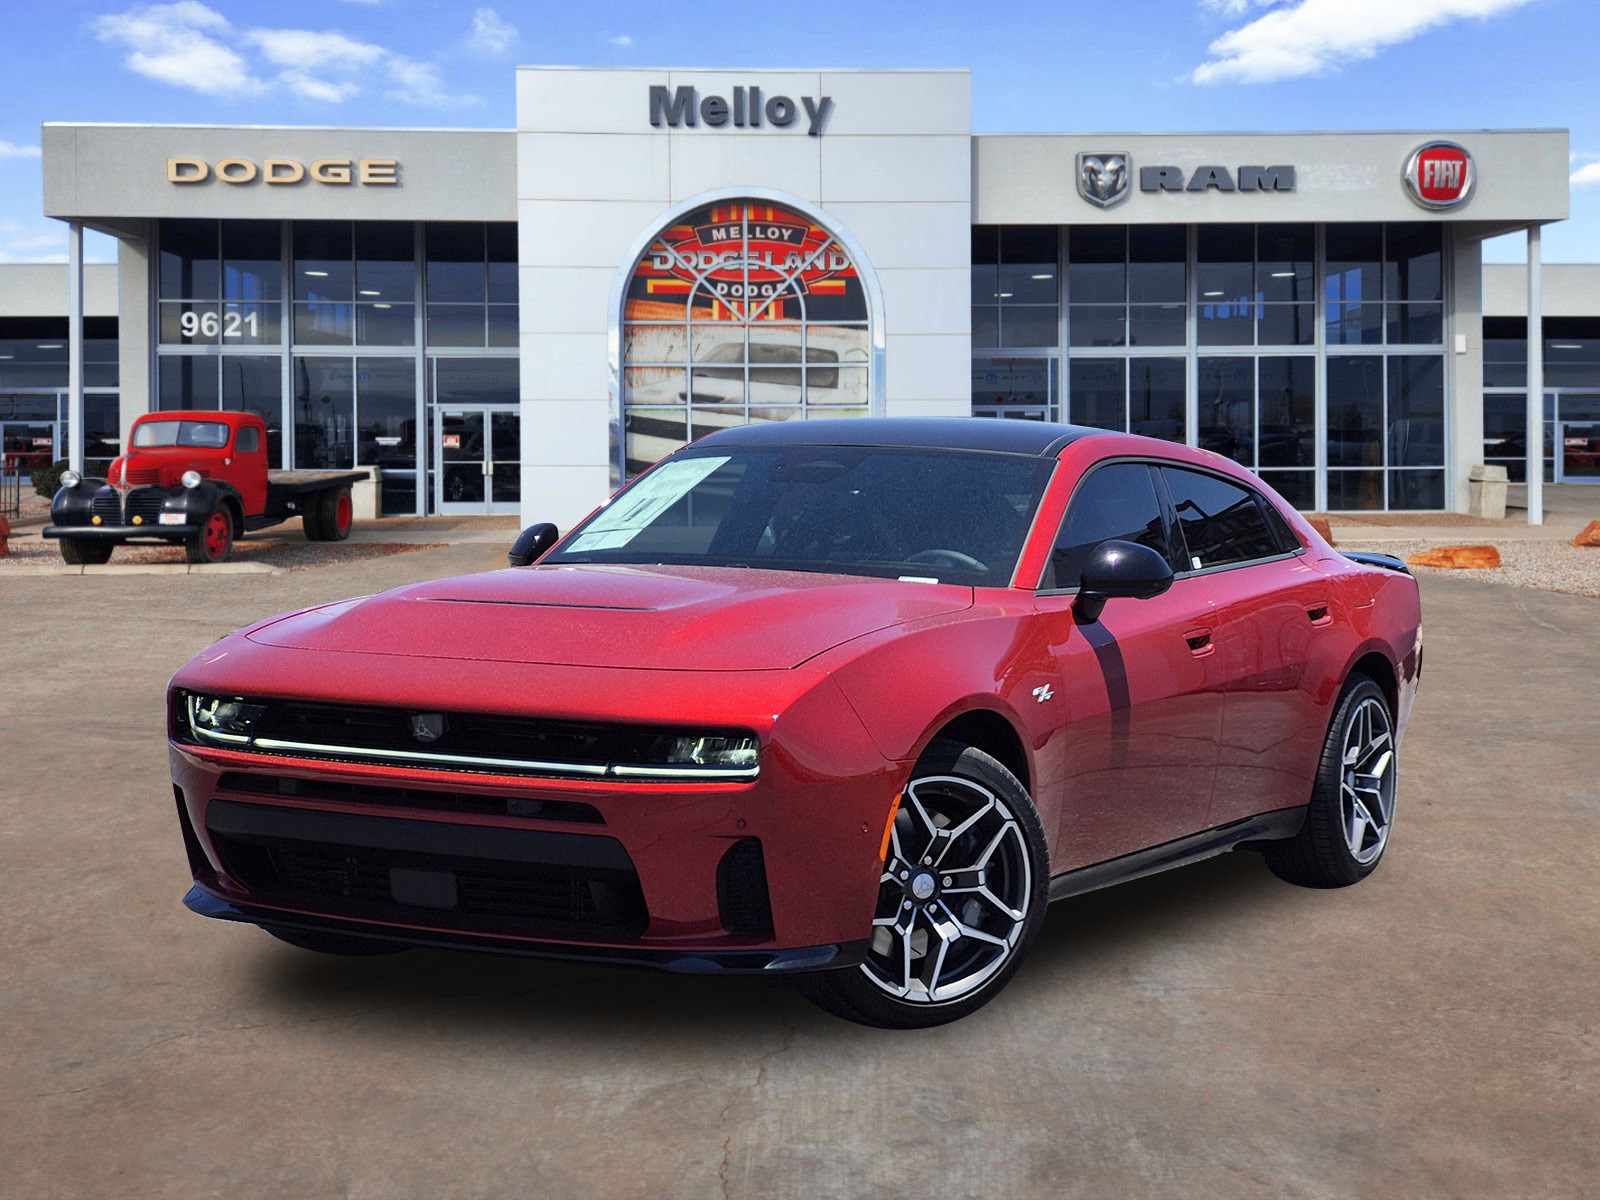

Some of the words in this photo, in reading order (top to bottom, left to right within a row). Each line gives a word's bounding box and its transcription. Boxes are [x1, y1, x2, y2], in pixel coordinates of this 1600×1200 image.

[649, 85, 832, 136] Melloy
[167, 158, 397, 185] DODGE
[1140, 165, 1296, 192] RAM
[1424, 159, 1463, 189] FIAT
[181, 311, 257, 337] 9621
